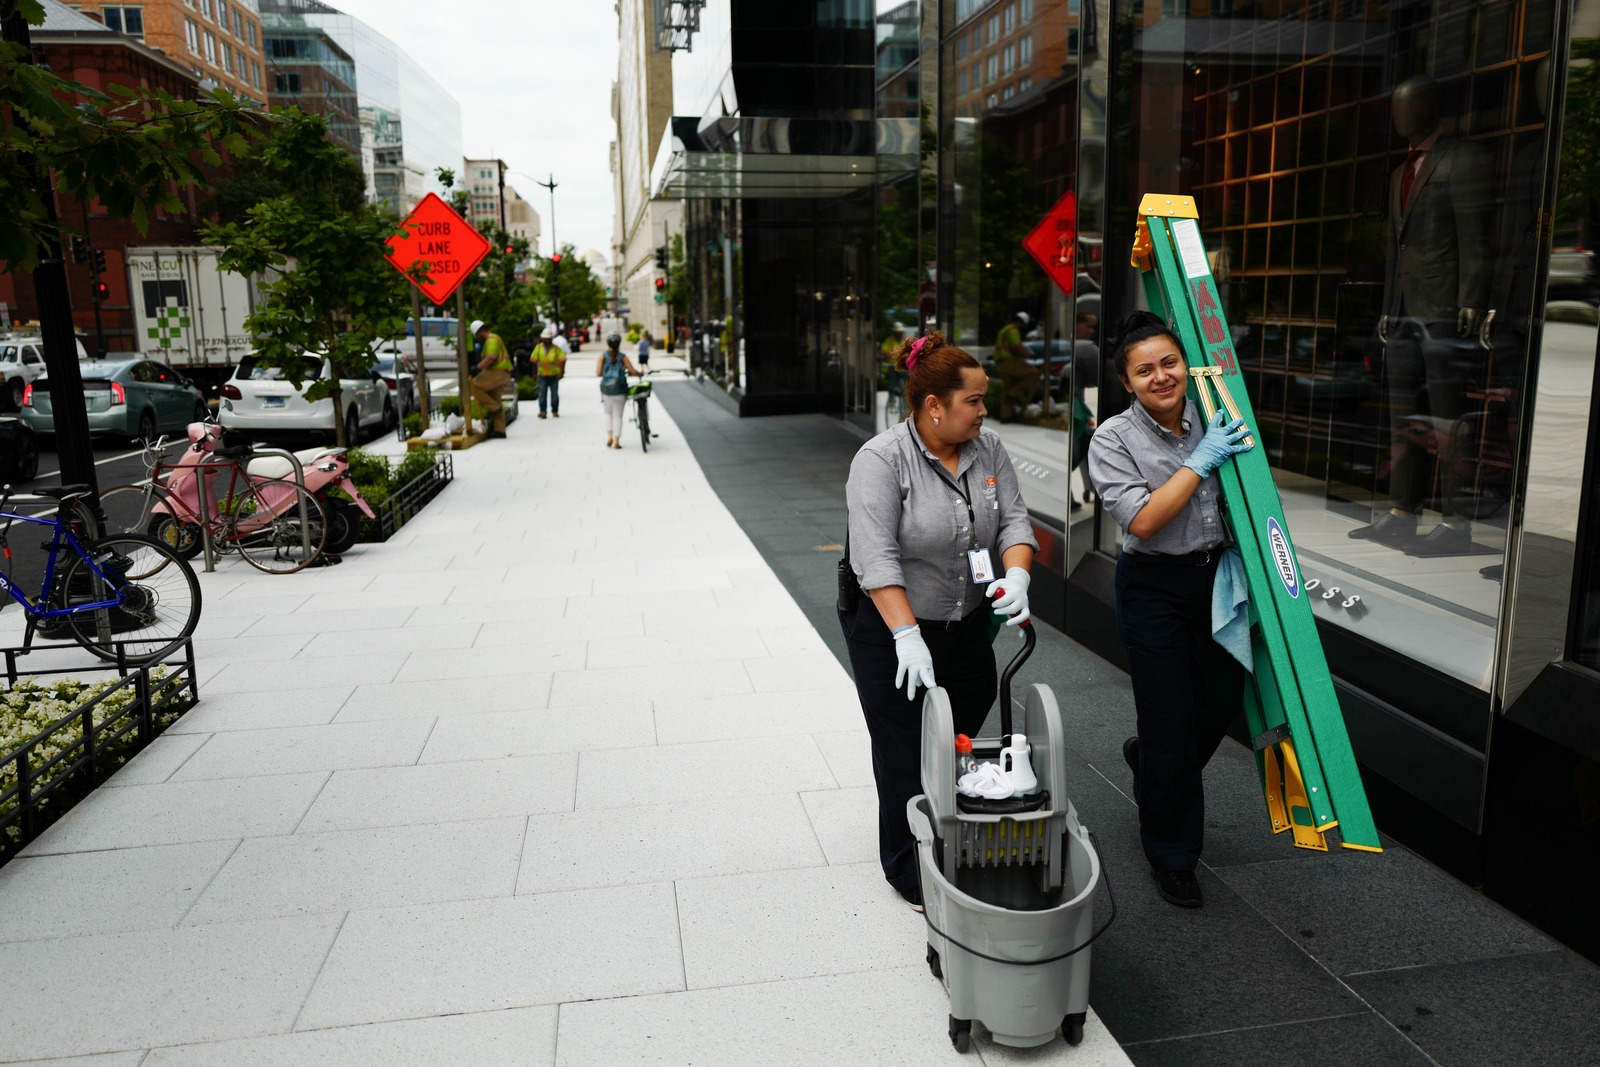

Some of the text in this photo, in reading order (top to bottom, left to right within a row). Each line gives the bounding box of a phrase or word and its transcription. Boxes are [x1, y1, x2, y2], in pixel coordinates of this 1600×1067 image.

[418, 222, 451, 236] CURB
[418, 241, 452, 255] LANE
[415, 260, 461, 274] OSED
[1272, 533, 1293, 581] WERNER
[1304, 578, 1361, 608] OSS
